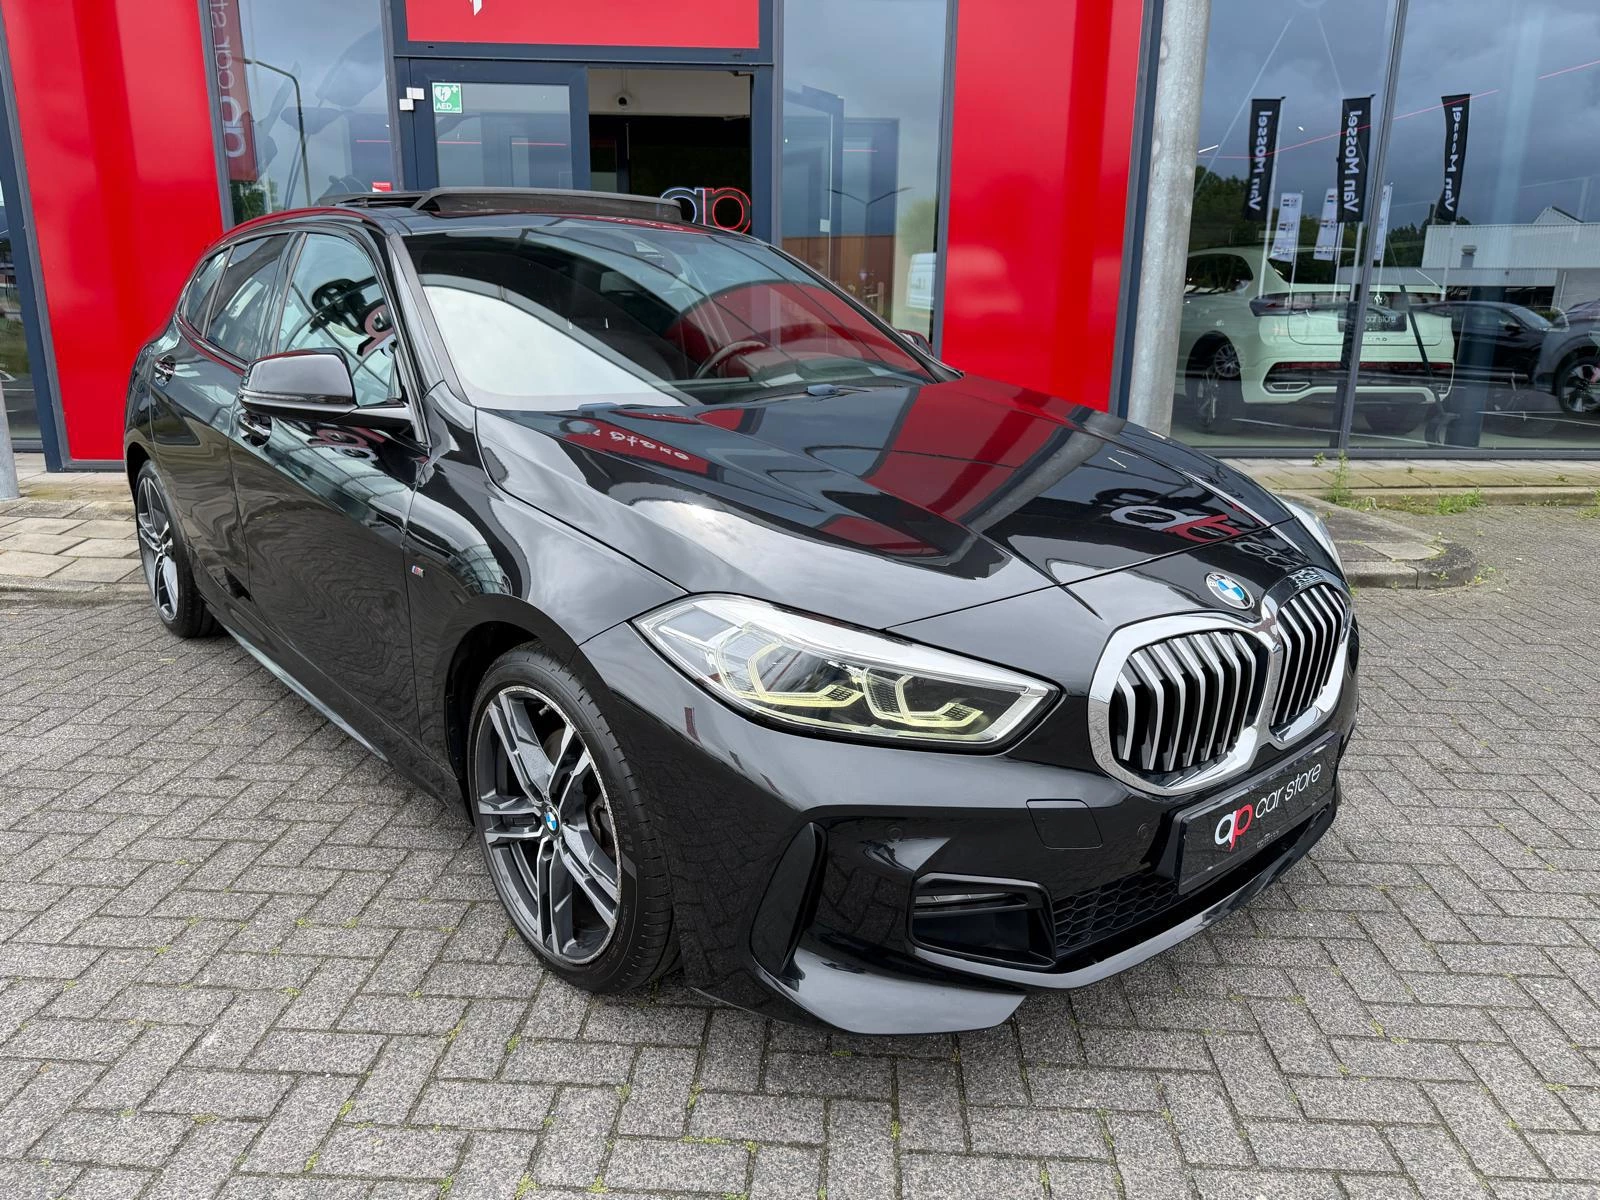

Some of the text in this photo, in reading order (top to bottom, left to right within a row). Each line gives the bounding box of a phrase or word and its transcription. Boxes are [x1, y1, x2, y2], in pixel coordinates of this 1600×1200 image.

[436, 102, 453, 110] AED
[1214, 803, 1254, 853] ap
[1255, 786, 1285, 819] car
[1285, 763, 1322, 802] store
